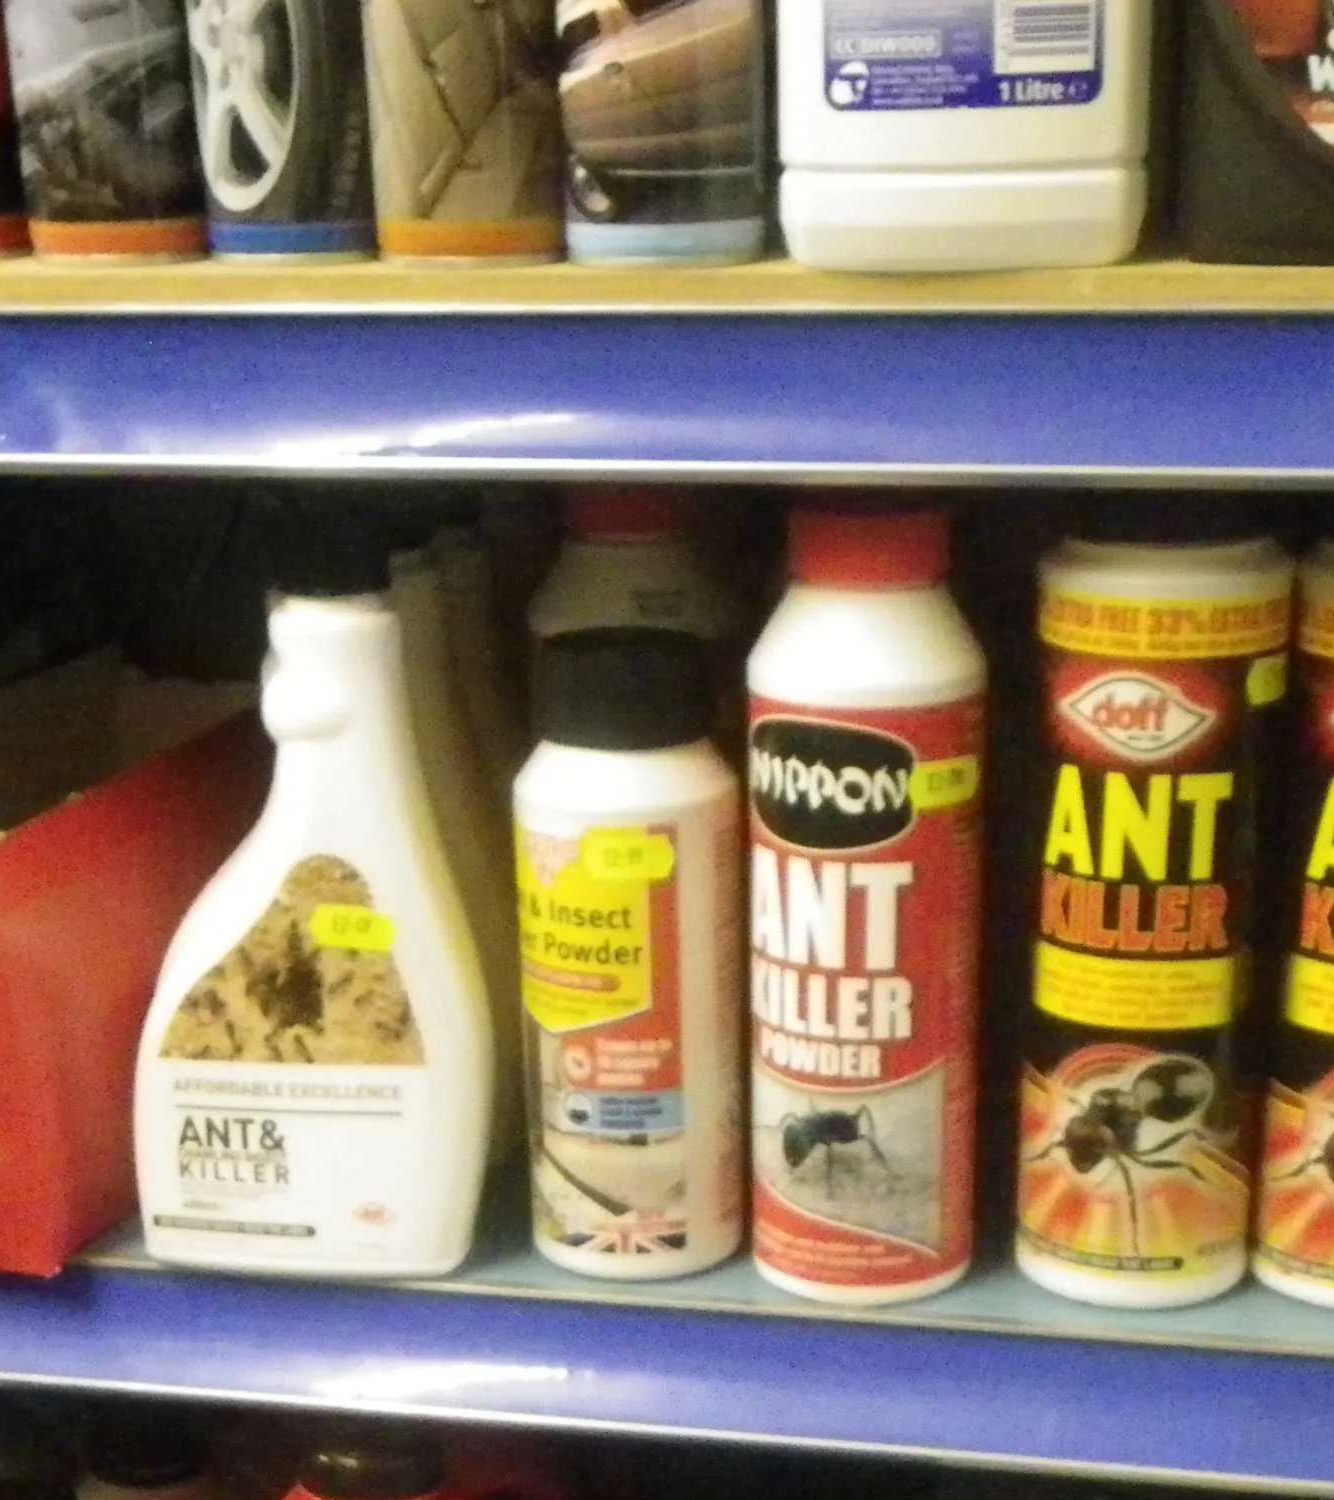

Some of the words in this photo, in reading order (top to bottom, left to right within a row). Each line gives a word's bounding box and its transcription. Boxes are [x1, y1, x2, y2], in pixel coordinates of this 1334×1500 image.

[1015, 78, 1064, 102] Litre
[1091, 690, 1168, 731] doff
[751, 747, 909, 815] NIPPON
[1044, 763, 1234, 882] ANT
[547, 894, 633, 930] Insect
[751, 842, 914, 971] ANT
[1040, 866, 1228, 952] KILLER
[543, 930, 646, 967] Powder
[752, 953, 914, 1043] KILLER
[760, 1032, 882, 1079] POWDER
[174, 1078, 287, 1098] AFFORDABLE
[290, 1083, 403, 1101] EXCELLENCE
[180, 1159, 291, 1185] KILLER
